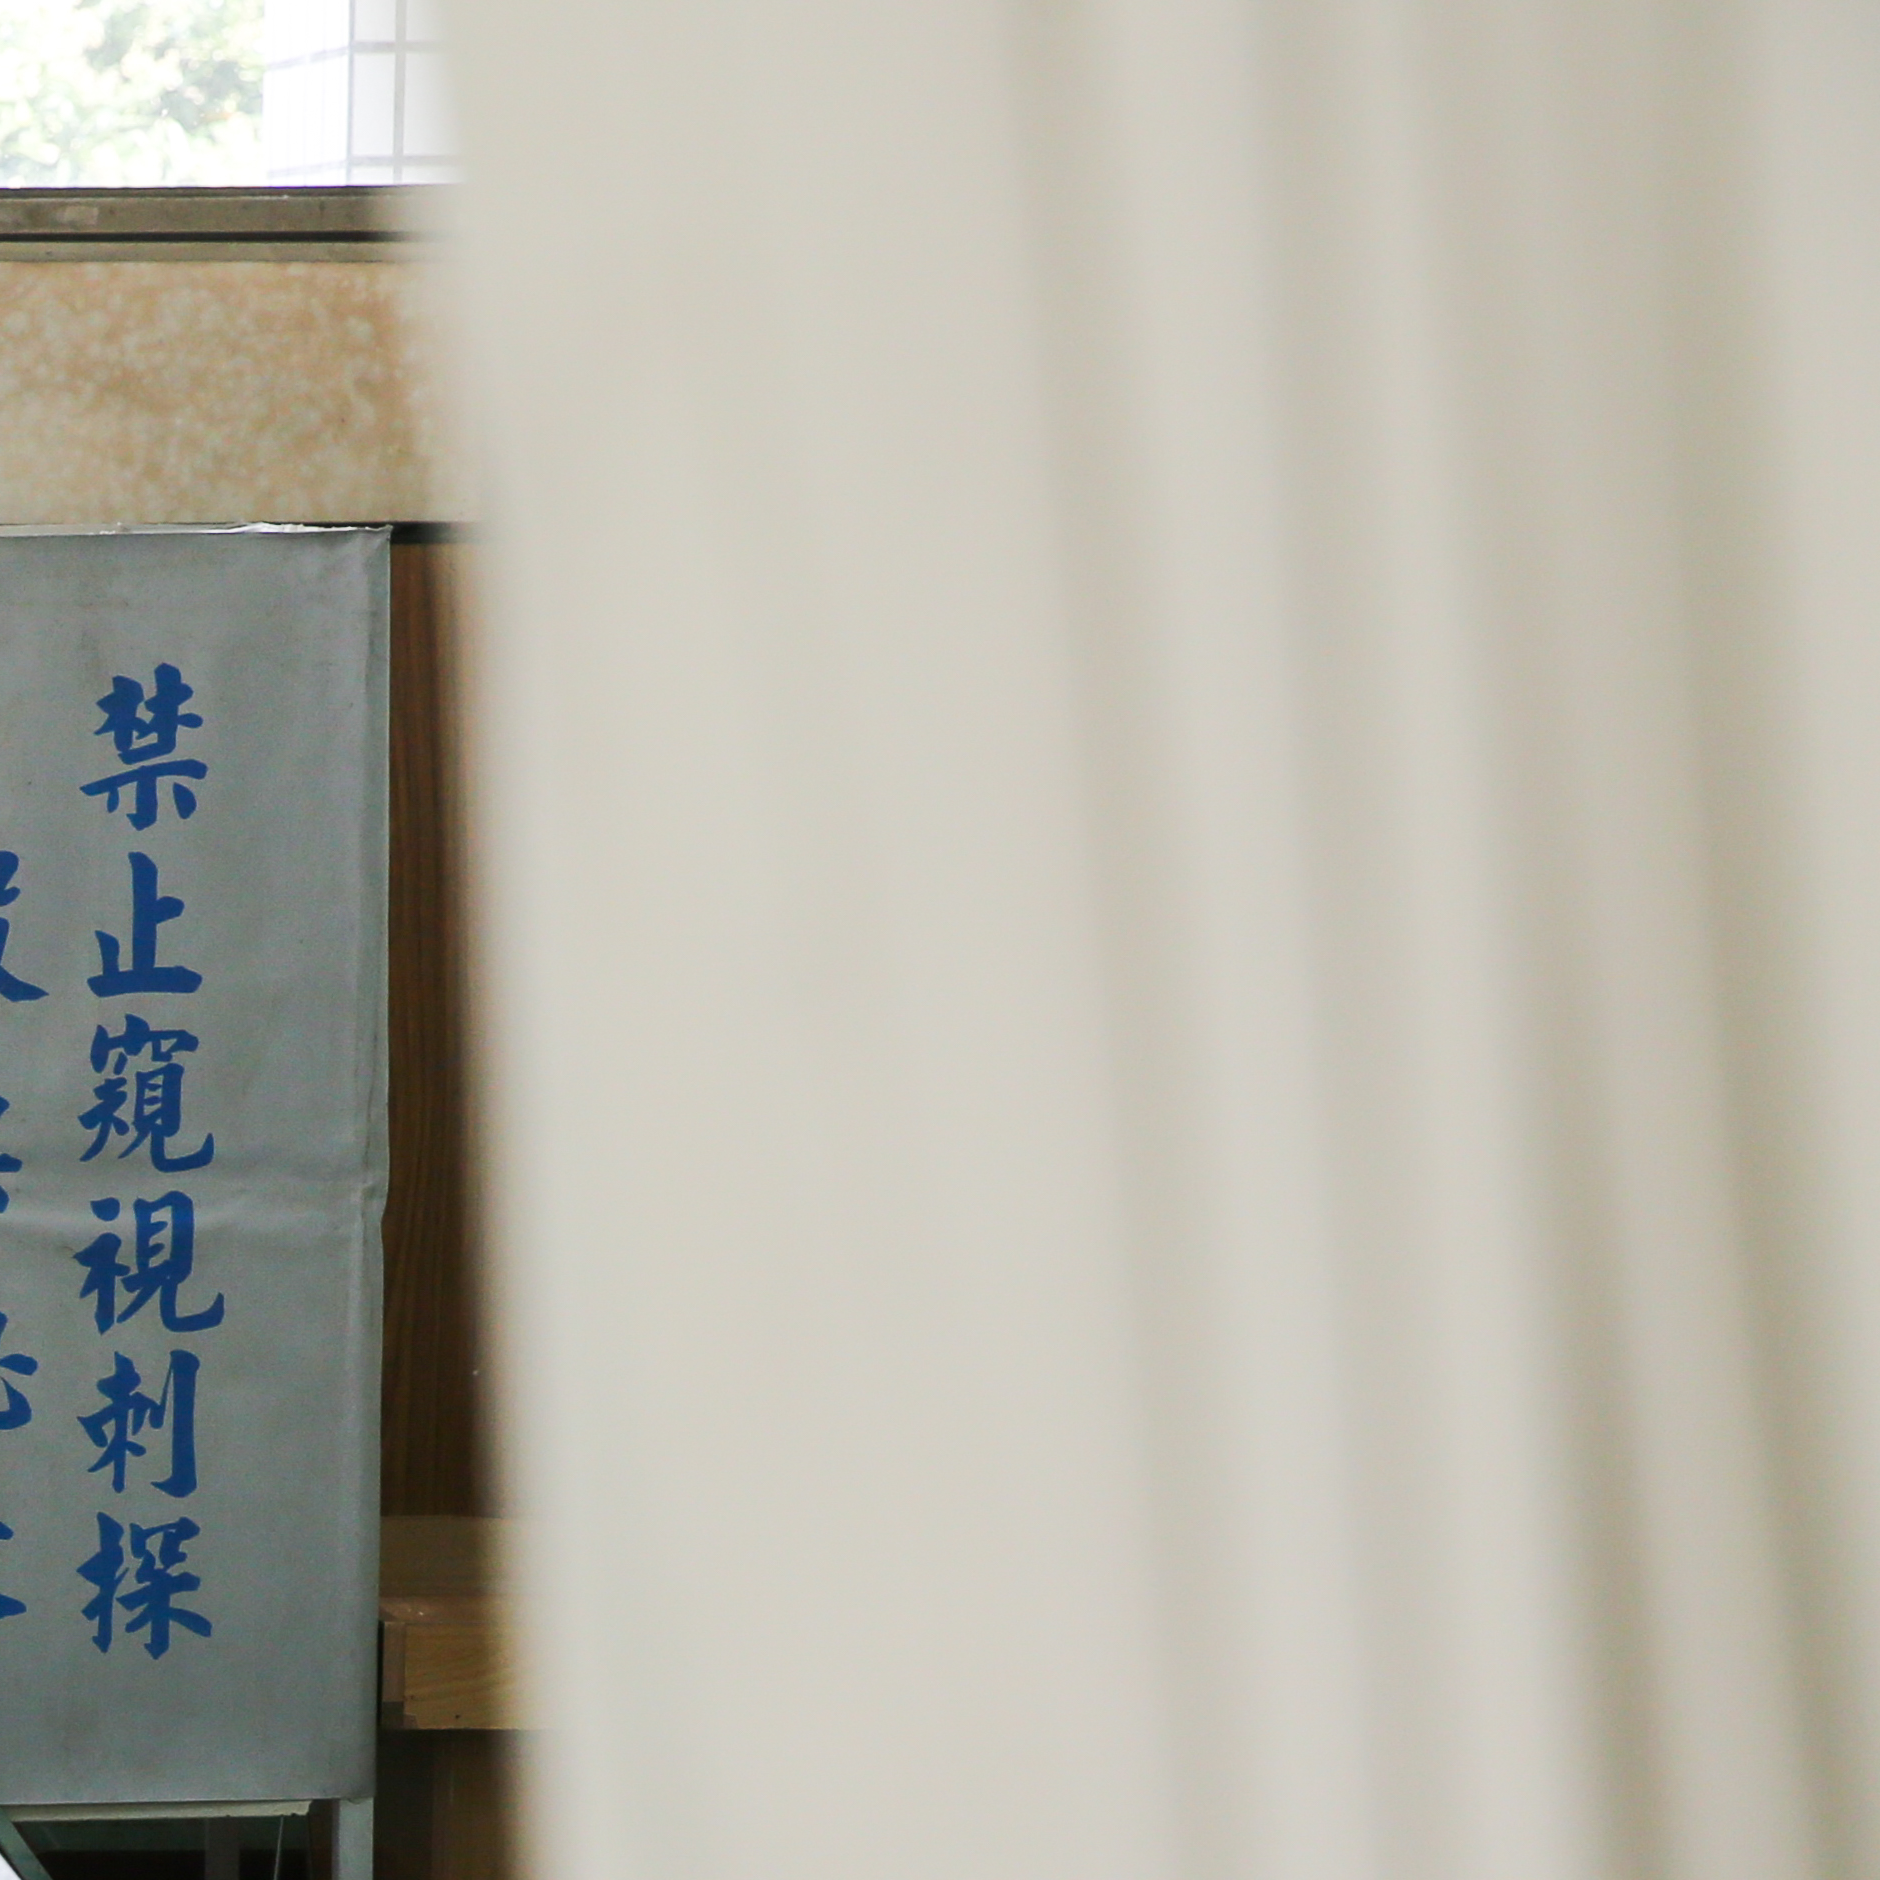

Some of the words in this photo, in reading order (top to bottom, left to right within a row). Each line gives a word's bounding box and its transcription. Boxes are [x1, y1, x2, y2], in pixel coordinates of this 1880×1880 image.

[73, 663, 224, 1659] 禁止窺視刺探
